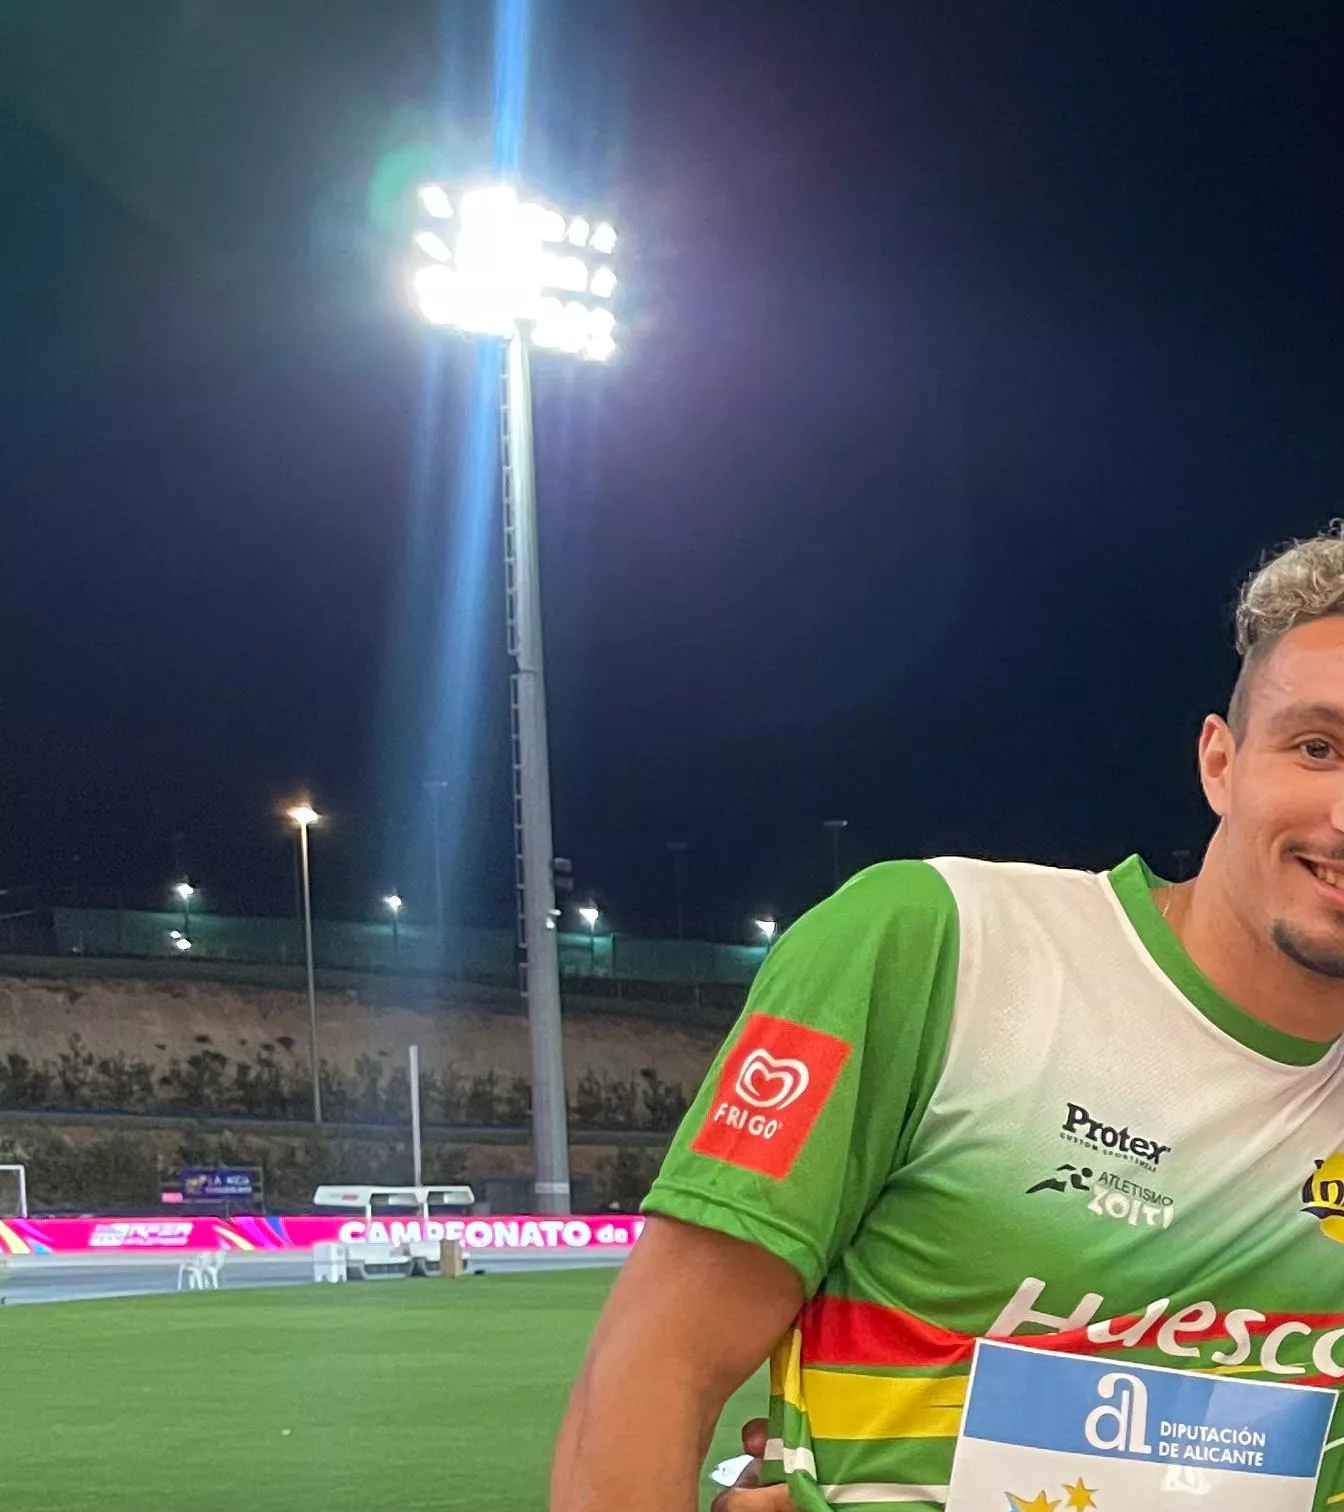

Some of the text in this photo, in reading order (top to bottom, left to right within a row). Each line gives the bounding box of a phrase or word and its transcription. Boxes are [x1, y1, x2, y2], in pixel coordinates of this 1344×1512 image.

[714, 1103, 777, 1139] FRIGO
[1062, 1102, 1171, 1165] Protex
[1087, 1183, 1174, 1229] ZOITI
[1098, 1172, 1174, 1206] ATLETISMO
[338, 1219, 592, 1248] CAMPEONATO
[1160, 1420, 1266, 1447] DIPUTACIÓN
[1159, 1440, 1264, 1467] DE ALICANTE
